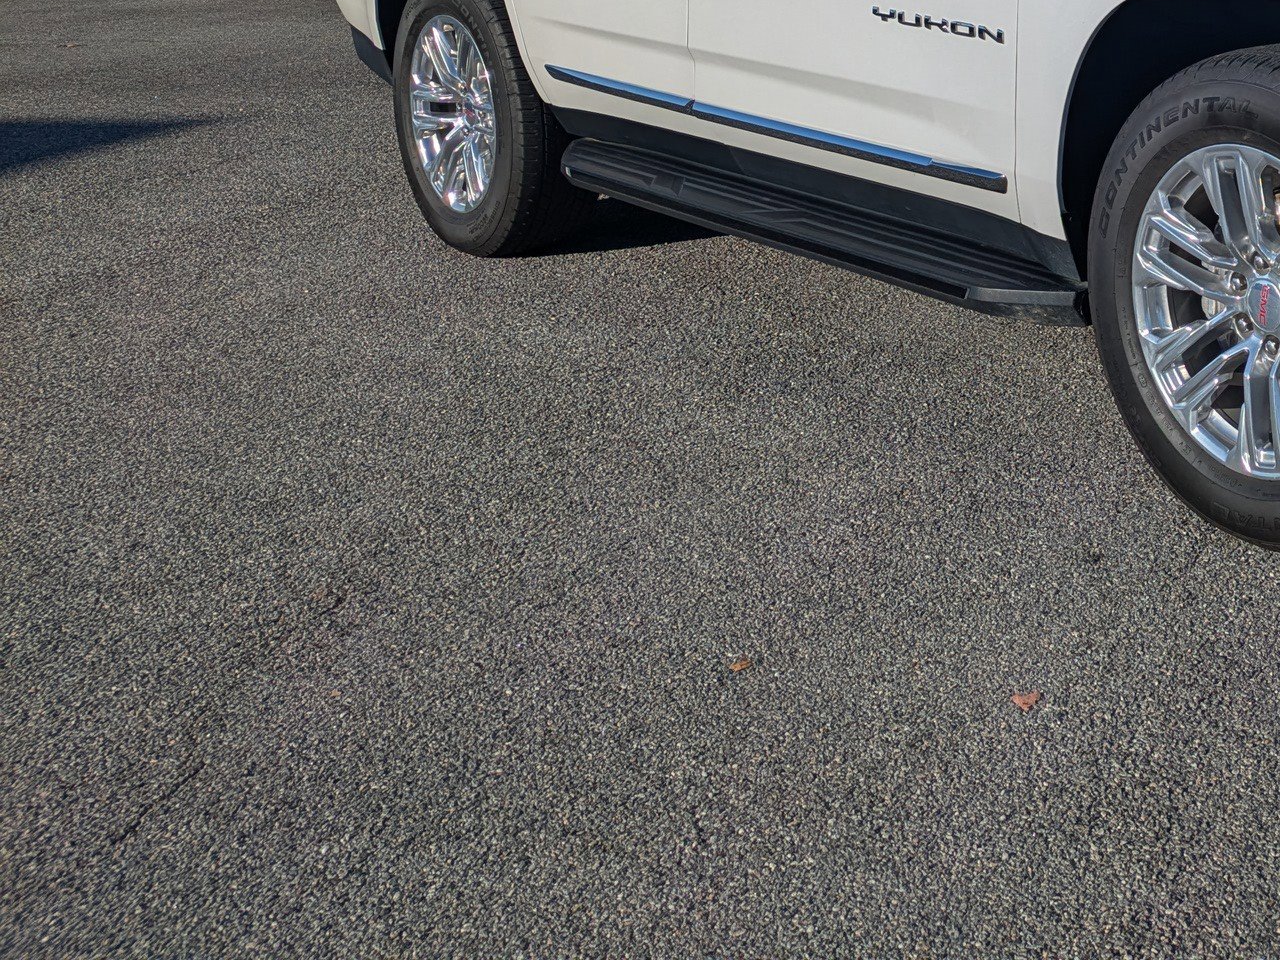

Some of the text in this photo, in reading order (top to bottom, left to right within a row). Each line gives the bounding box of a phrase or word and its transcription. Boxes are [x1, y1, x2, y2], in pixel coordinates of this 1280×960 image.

[872, 5, 1005, 44] YUKON
[1100, 96, 1259, 239] CONTINENTAL
[1259, 284, 1271, 327] GMC
